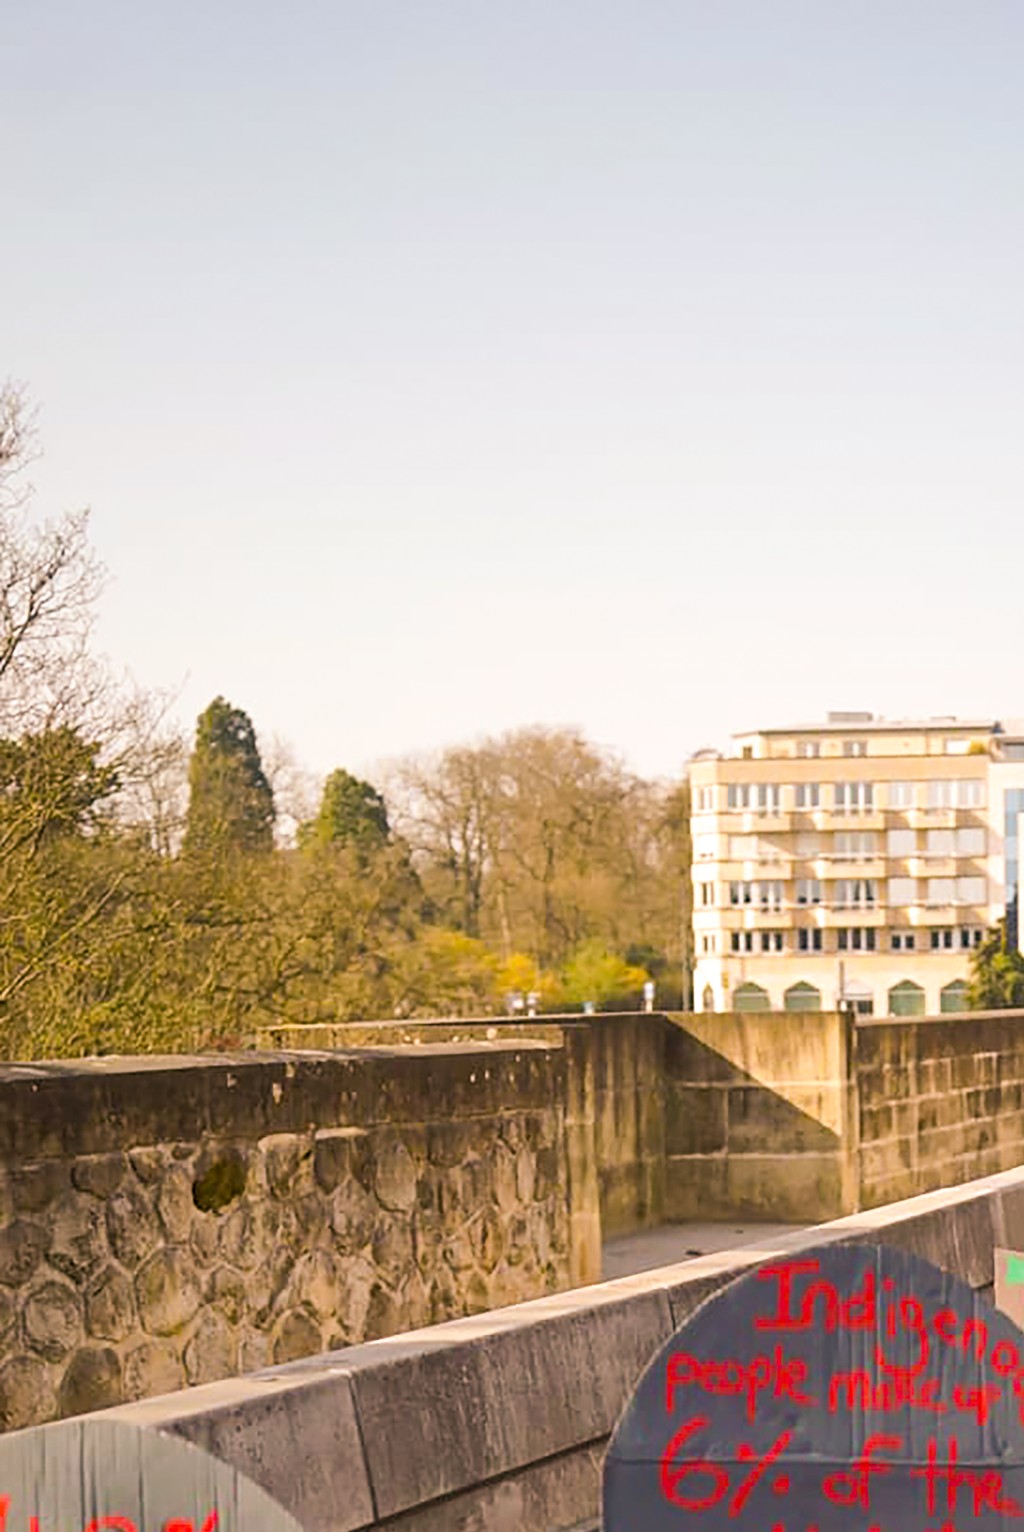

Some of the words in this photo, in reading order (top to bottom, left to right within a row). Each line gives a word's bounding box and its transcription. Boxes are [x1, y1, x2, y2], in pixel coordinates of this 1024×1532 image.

[666, 1345, 810, 1425] people
[660, 1414, 790, 1517] 6%
[911, 1436, 1023, 1516] the
